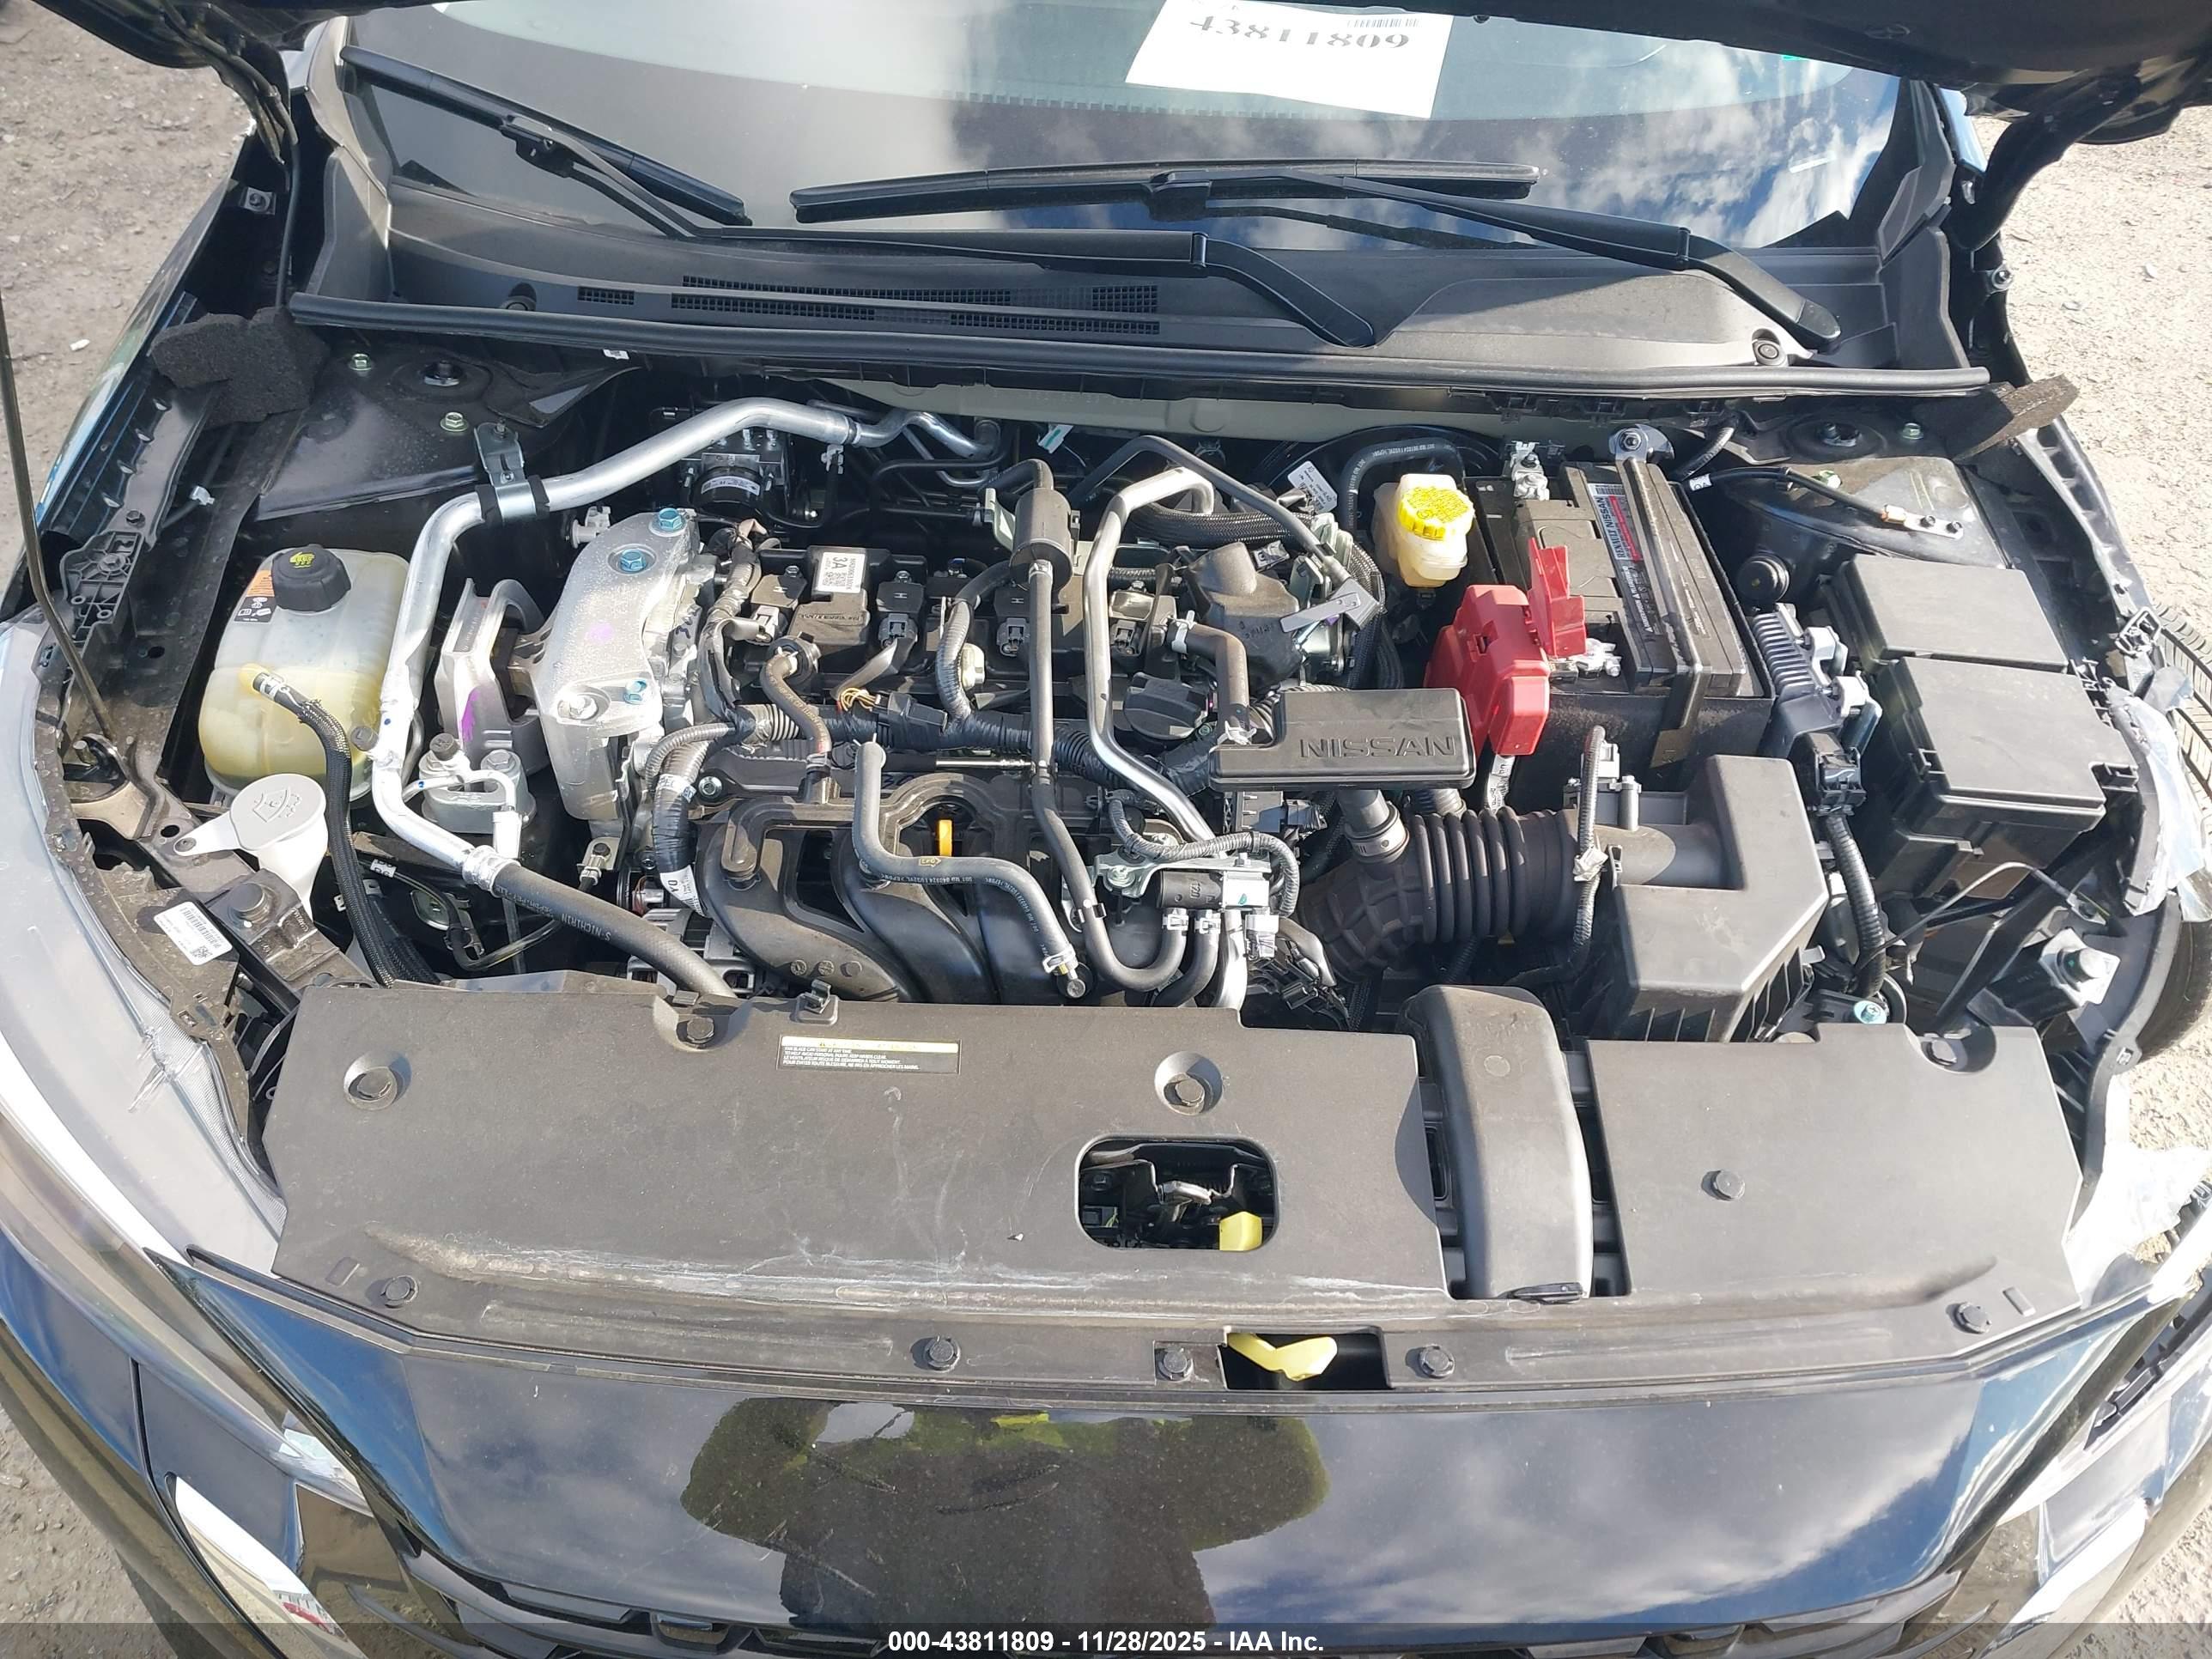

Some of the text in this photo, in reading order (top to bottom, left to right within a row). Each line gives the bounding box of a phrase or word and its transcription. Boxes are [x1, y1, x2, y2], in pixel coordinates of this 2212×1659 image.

[1189, 15, 1410, 49] 43811809
[1595, 496, 1615, 530] NISSAN
[1298, 735, 1457, 760] NISSAN
